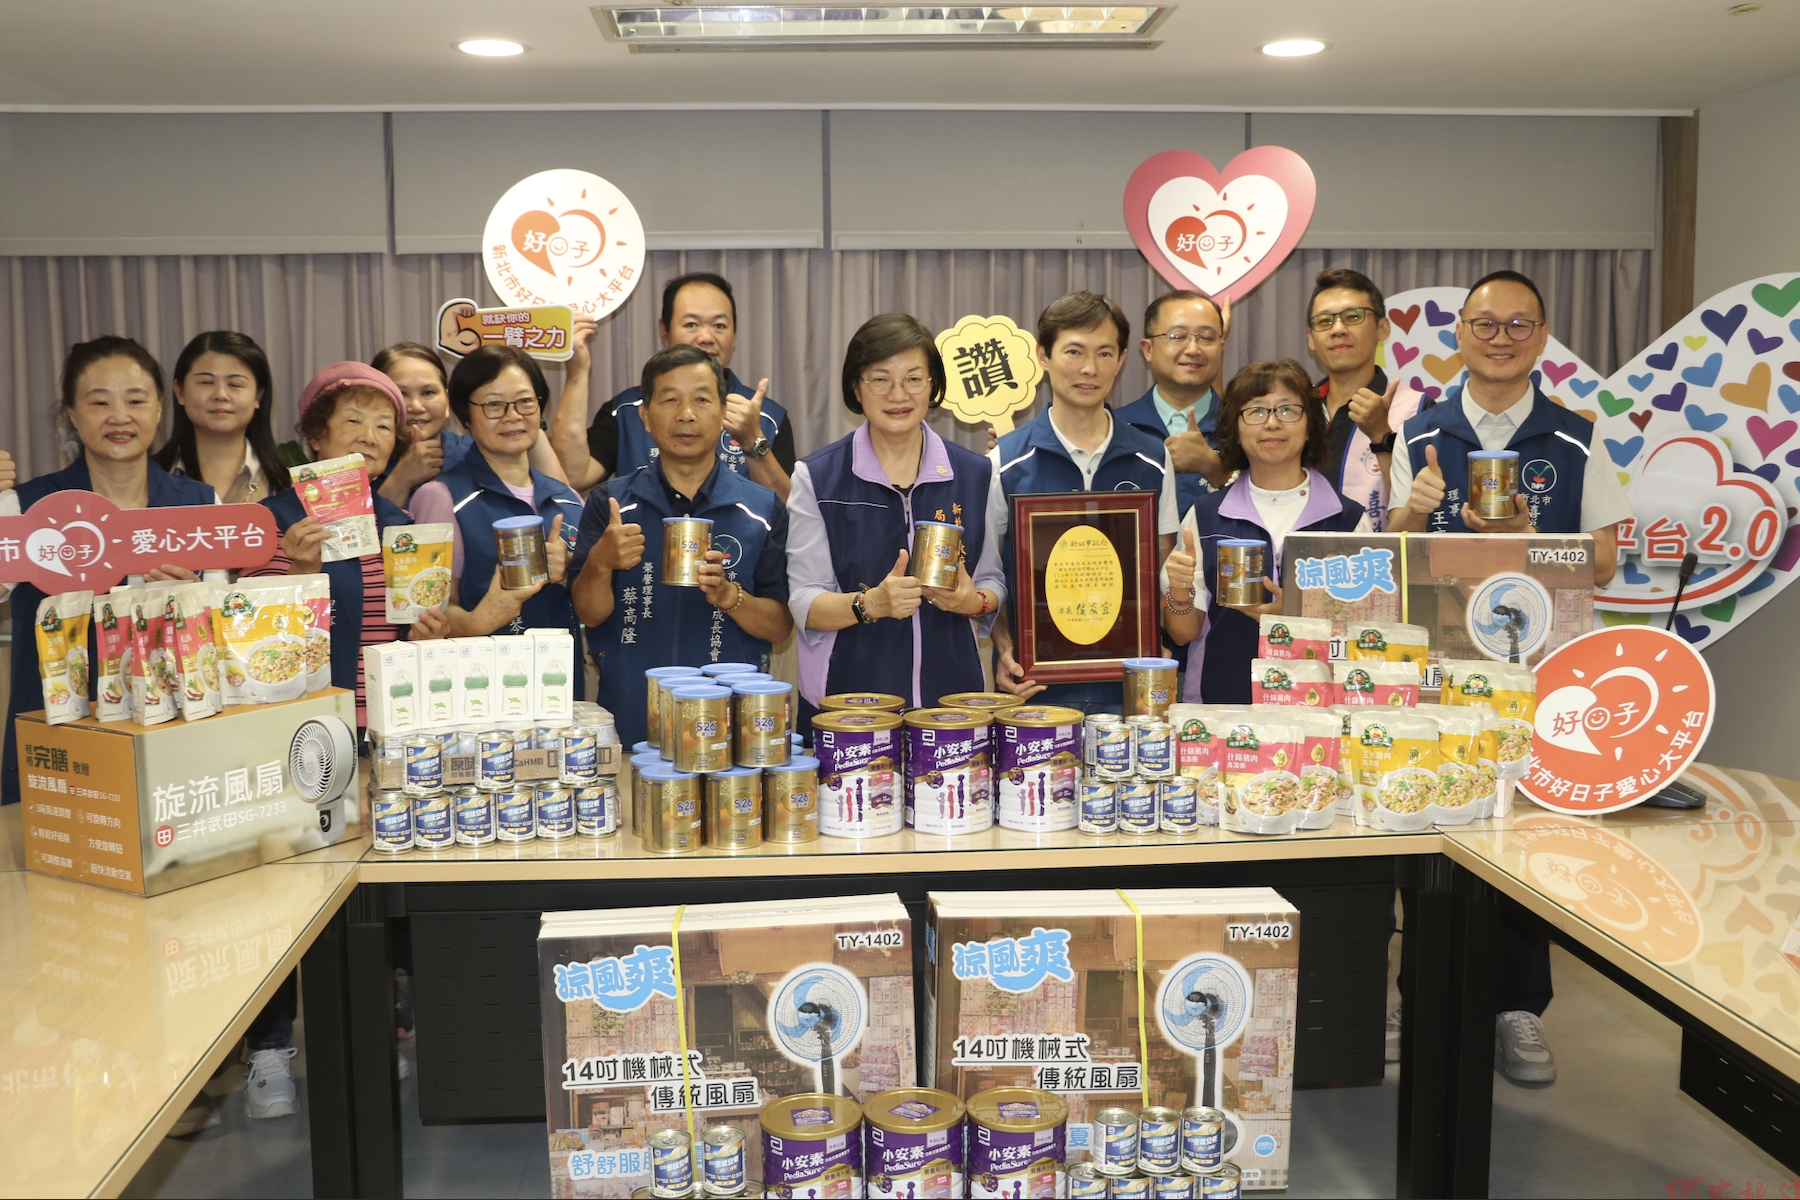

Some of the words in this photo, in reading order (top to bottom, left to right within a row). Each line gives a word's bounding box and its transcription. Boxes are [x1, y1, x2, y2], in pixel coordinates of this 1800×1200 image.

[482, 312, 531, 325] 就缺你的
[483, 327, 566, 348] 一臂之力
[953, 337, 1018, 399] 讚
[132, 524, 265, 554] 愛心大平台
[1530, 550, 1585, 562] TY-1402
[641, 562, 653, 619] 榮譽理事長
[621, 587, 638, 644] 蔡高隆
[709, 605, 724, 662] 成長協會
[833, 743, 871, 760] 小安素
[934, 740, 973, 758] 小安素
[1015, 738, 1053, 756] 小安素
[34, 745, 68, 772] 完膳
[1227, 753, 1258, 763] 什錦豬肉
[28, 774, 67, 794] 旋流風扇
[152, 760, 284, 823] 旋流風扇
[838, 933, 901, 948] TY-1402
[1229, 926, 1290, 939] TY-1402
[956, 1037, 1088, 1059] 14吋機械式
[565, 1054, 702, 1082] 14吋機械式
[1037, 1066, 1139, 1090] 傳統風扇
[651, 1081, 755, 1109] 傳統風扇
[1068, 1127, 1089, 1146] 夏
[782, 1152, 824, 1170] 小安素
[882, 1145, 925, 1162] 小安素
[988, 1145, 1032, 1161] 小安素
[573, 1152, 651, 1176] 舒舒服
[784, 1166, 822, 1181] PediaSure
[884, 1159, 922, 1173] PediaSure
[990, 1159, 1029, 1172] PediaSure
